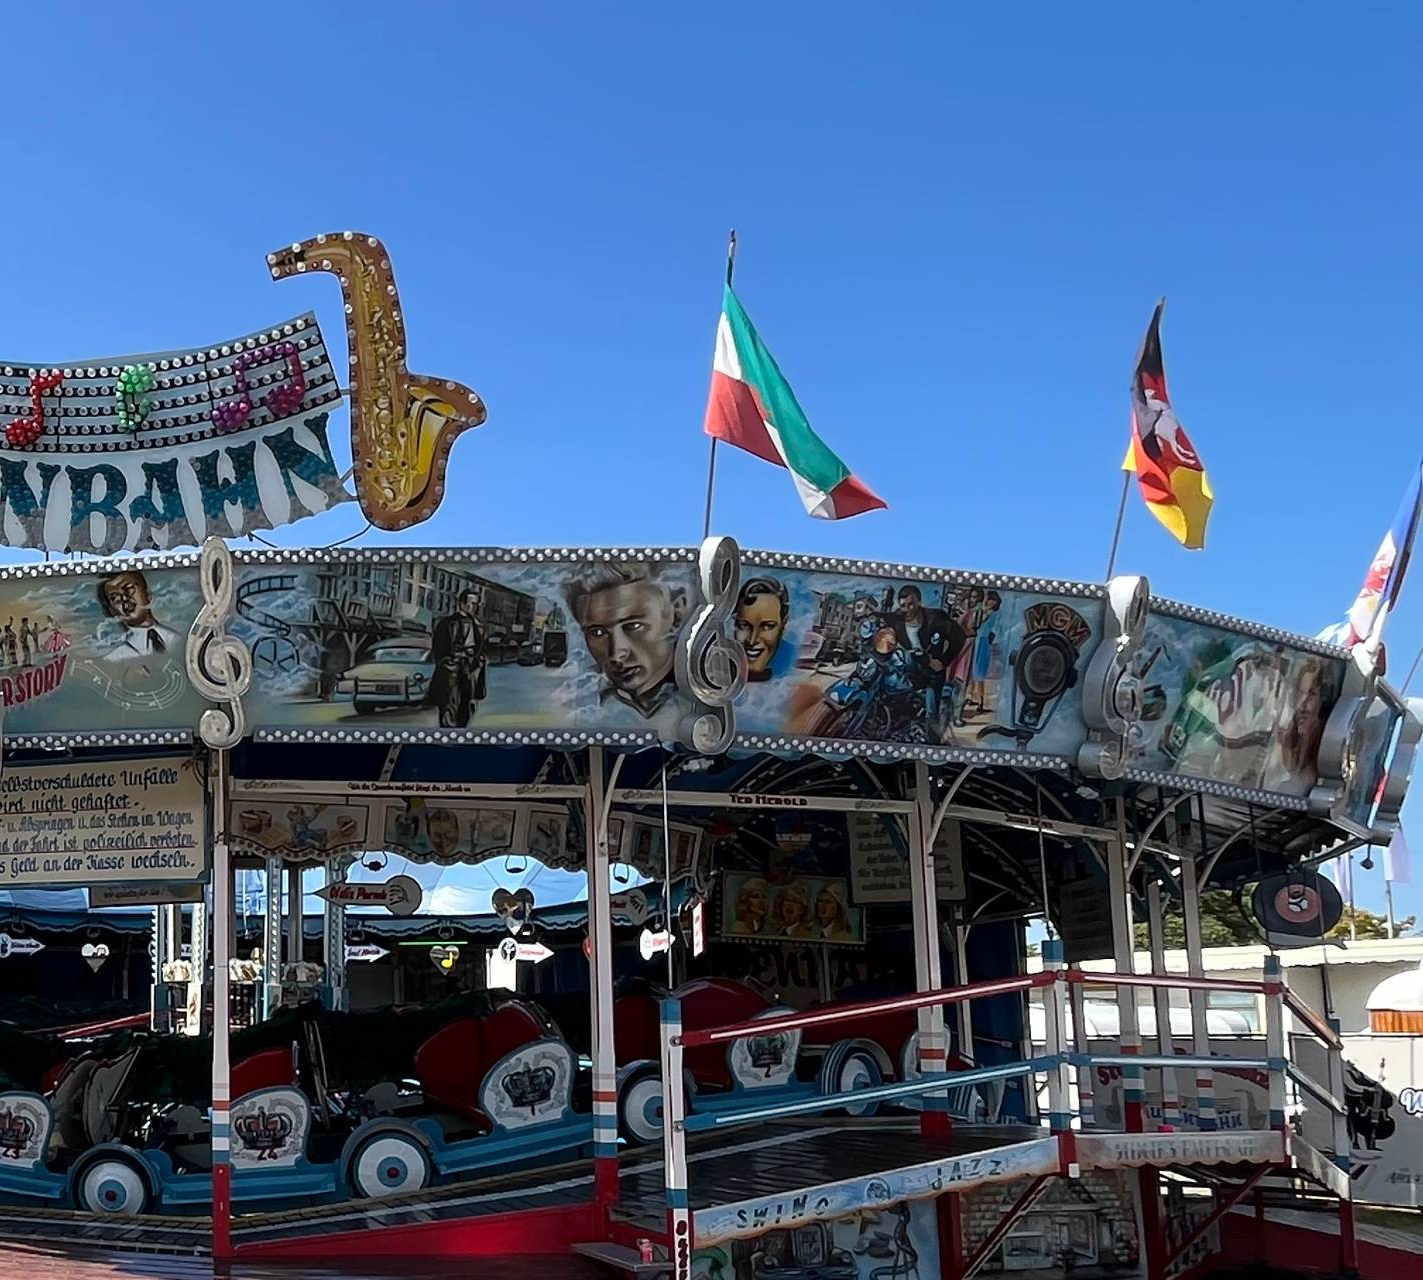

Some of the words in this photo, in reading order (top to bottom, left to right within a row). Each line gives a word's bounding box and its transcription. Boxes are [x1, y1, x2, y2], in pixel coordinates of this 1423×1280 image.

[1026, 605, 1089, 646] MGM
[16, 654, 68, 702] STORY
[123, 768, 178, 790] Unfälle
[32, 793, 65, 816] nicht
[729, 793, 753, 804] TED
[157, 811, 193, 830] Wagen
[13, 837, 29, 851] der
[83, 830, 148, 853] polizeilich
[11, 857, 39, 878] Geld
[43, 858, 61, 872] an
[63, 855, 83, 871] der
[86, 853, 125, 868] Kasse
[931, 1159, 1002, 1191] JAZZ
